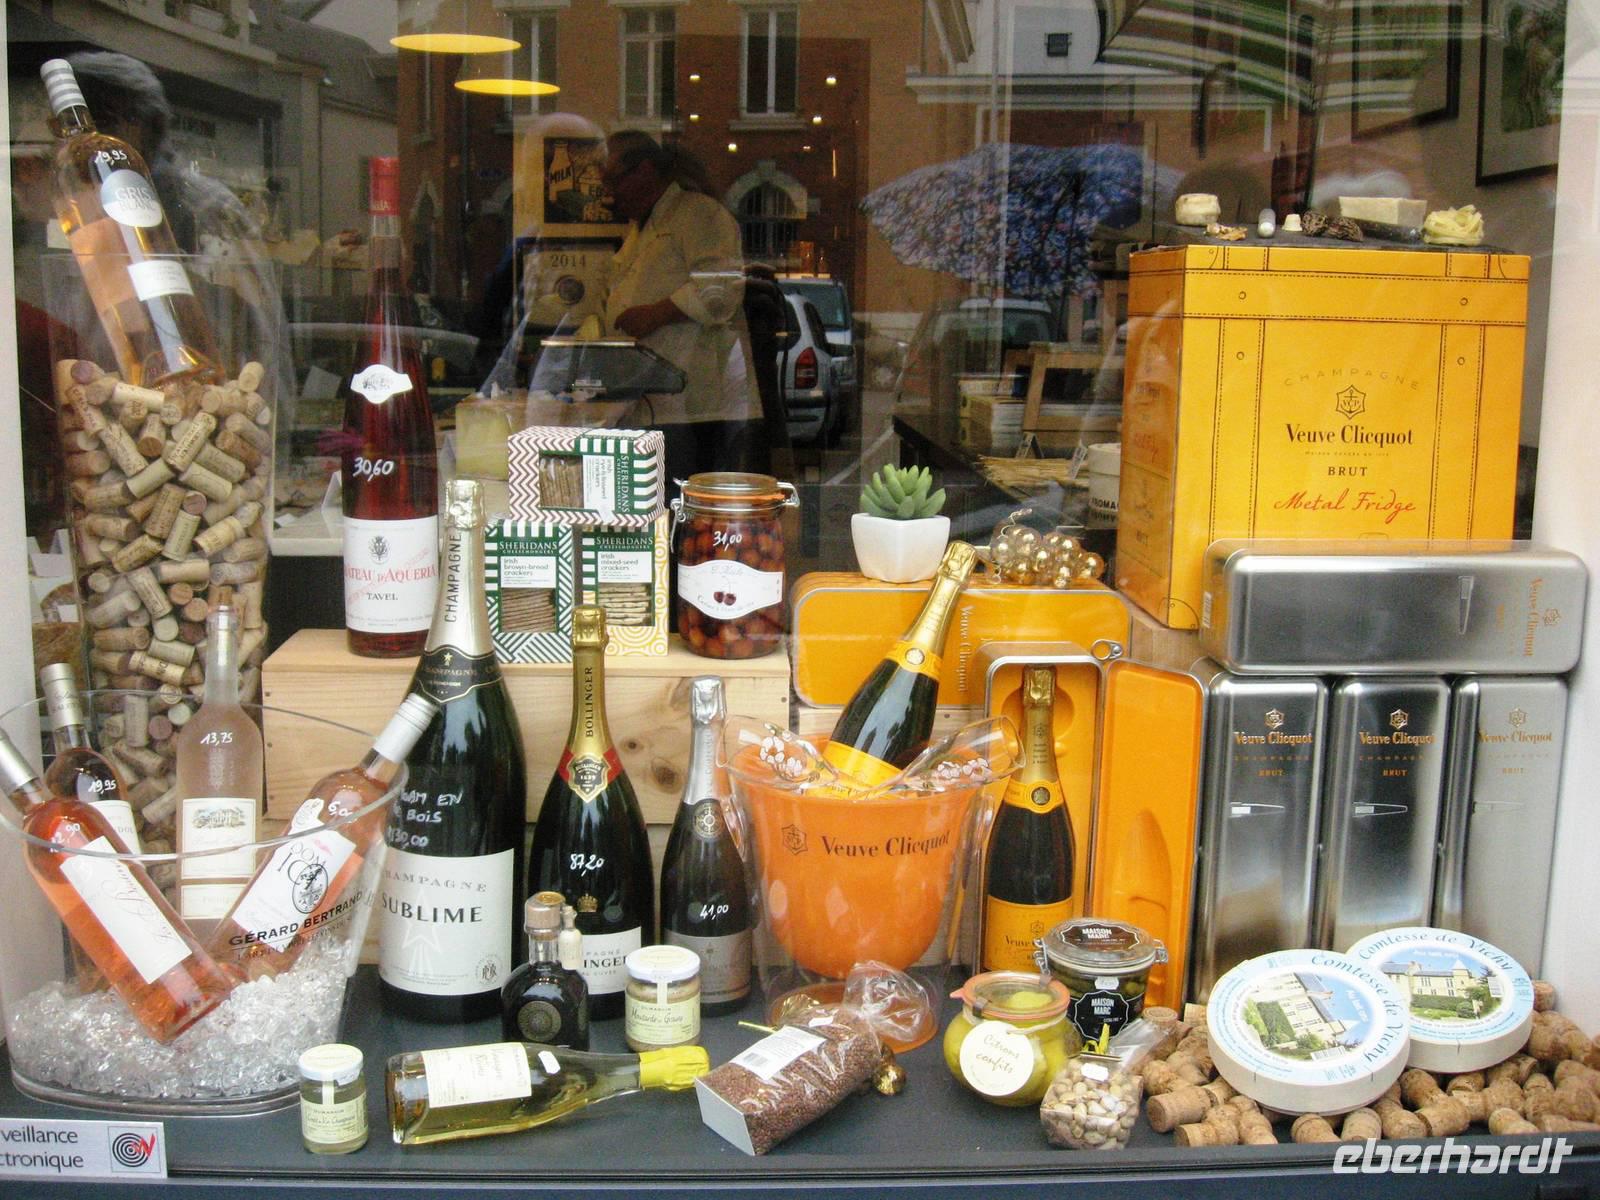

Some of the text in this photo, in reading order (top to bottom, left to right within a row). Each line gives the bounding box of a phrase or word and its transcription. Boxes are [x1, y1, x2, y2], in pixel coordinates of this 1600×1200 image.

[114, 187, 152, 201] GRIS
[551, 254, 587, 268] 2014
[1284, 368, 1419, 391] CHAMPAGNE
[1286, 423, 1414, 449] Veuve Clicquot
[353, 456, 395, 482] 30,60
[1327, 465, 1369, 477] BRUT
[620, 454, 631, 513] SHERIDANS
[1273, 487, 1417, 525] Metal Fridge
[500, 541, 558, 550] SHERIDANS
[596, 536, 654, 546] SHERIDANS
[444, 533, 463, 624] CHAMPAGNE
[366, 592, 399, 601] TAVEL
[584, 667, 594, 738] BOLLINGER
[200, 732, 234, 746] 13,75
[1233, 731, 1314, 747] Veuve Clicquot
[1358, 731, 1437, 747] Veuve Clicquot
[1256, 768, 1285, 777] BRUT
[1381, 768, 1408, 777] BRUT
[88, 779, 117, 794] 19,95
[820, 830, 951, 858] Veuve Clicquot
[569, 853, 605, 877] 87,20
[382, 892, 484, 924] SUBLIME
[700, 904, 730, 920] 41,00
[229, 921, 299, 946] GÉRARD
[303, 890, 363, 929] BERTRAND
[1082, 927, 1112, 936] MAISON
[1358, 932, 1513, 971] Comtesse de Vichy
[1311, 953, 1390, 995] Comtesse
[1091, 998, 1115, 1007] MAISON
[1094, 1006, 1112, 1016] MARC
[1385, 998, 1404, 1018] de
[1363, 1022, 1405, 1064] Vichy
[0, 1124, 79, 1144] veillance
